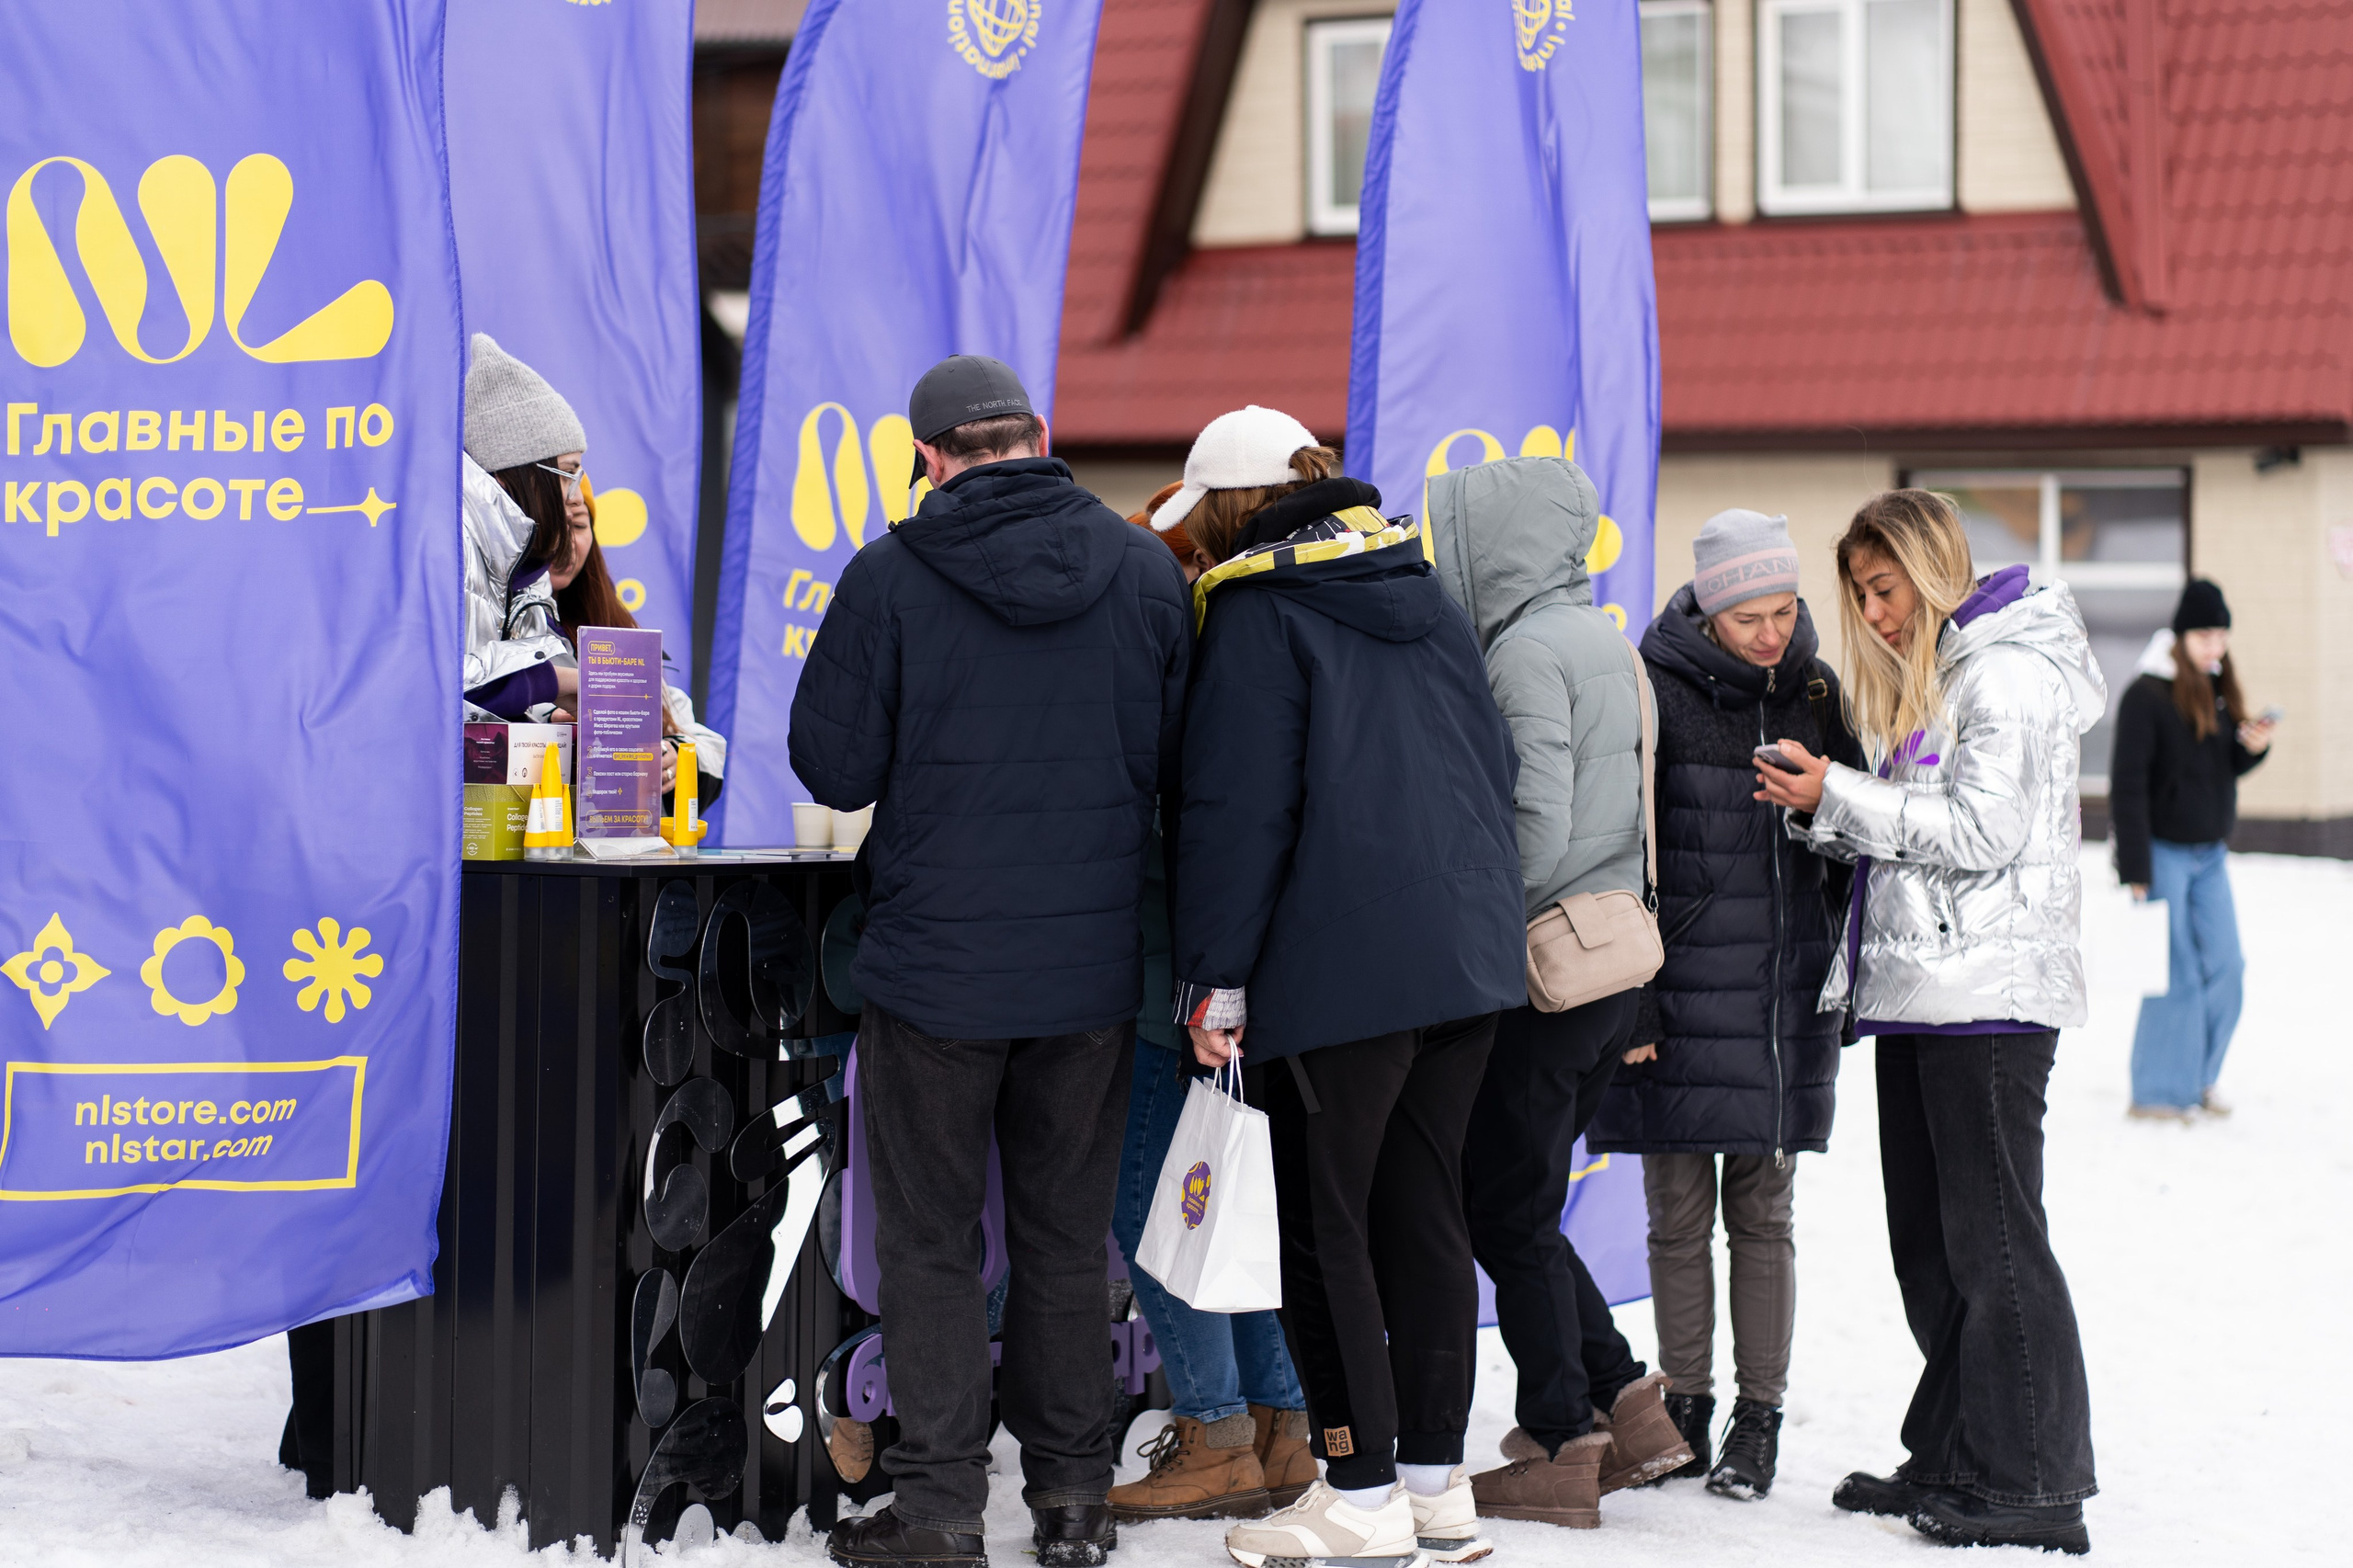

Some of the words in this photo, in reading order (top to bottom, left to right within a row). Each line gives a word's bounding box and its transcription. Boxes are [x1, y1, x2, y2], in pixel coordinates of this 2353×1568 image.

[6, 153, 394, 368] NL
[966, 403, 981, 413] THE
[982, 400, 1006, 410] NORTH
[7, 403, 306, 456] Главные
[326, 403, 394, 449] по
[4, 476, 304, 537] красоте
[590, 643, 613, 653] ПРИВЕТ,
[588, 656, 597, 665] ТЫ
[602, 656, 637, 665] БЬЮТИ-БАРЕ
[638, 658, 645, 666] NL
[506, 812, 529, 822] Collage
[506, 824, 527, 833] Peptid
[74, 1095, 297, 1126] nlstore.com
[85, 1133, 273, 1164] nlstar.com
